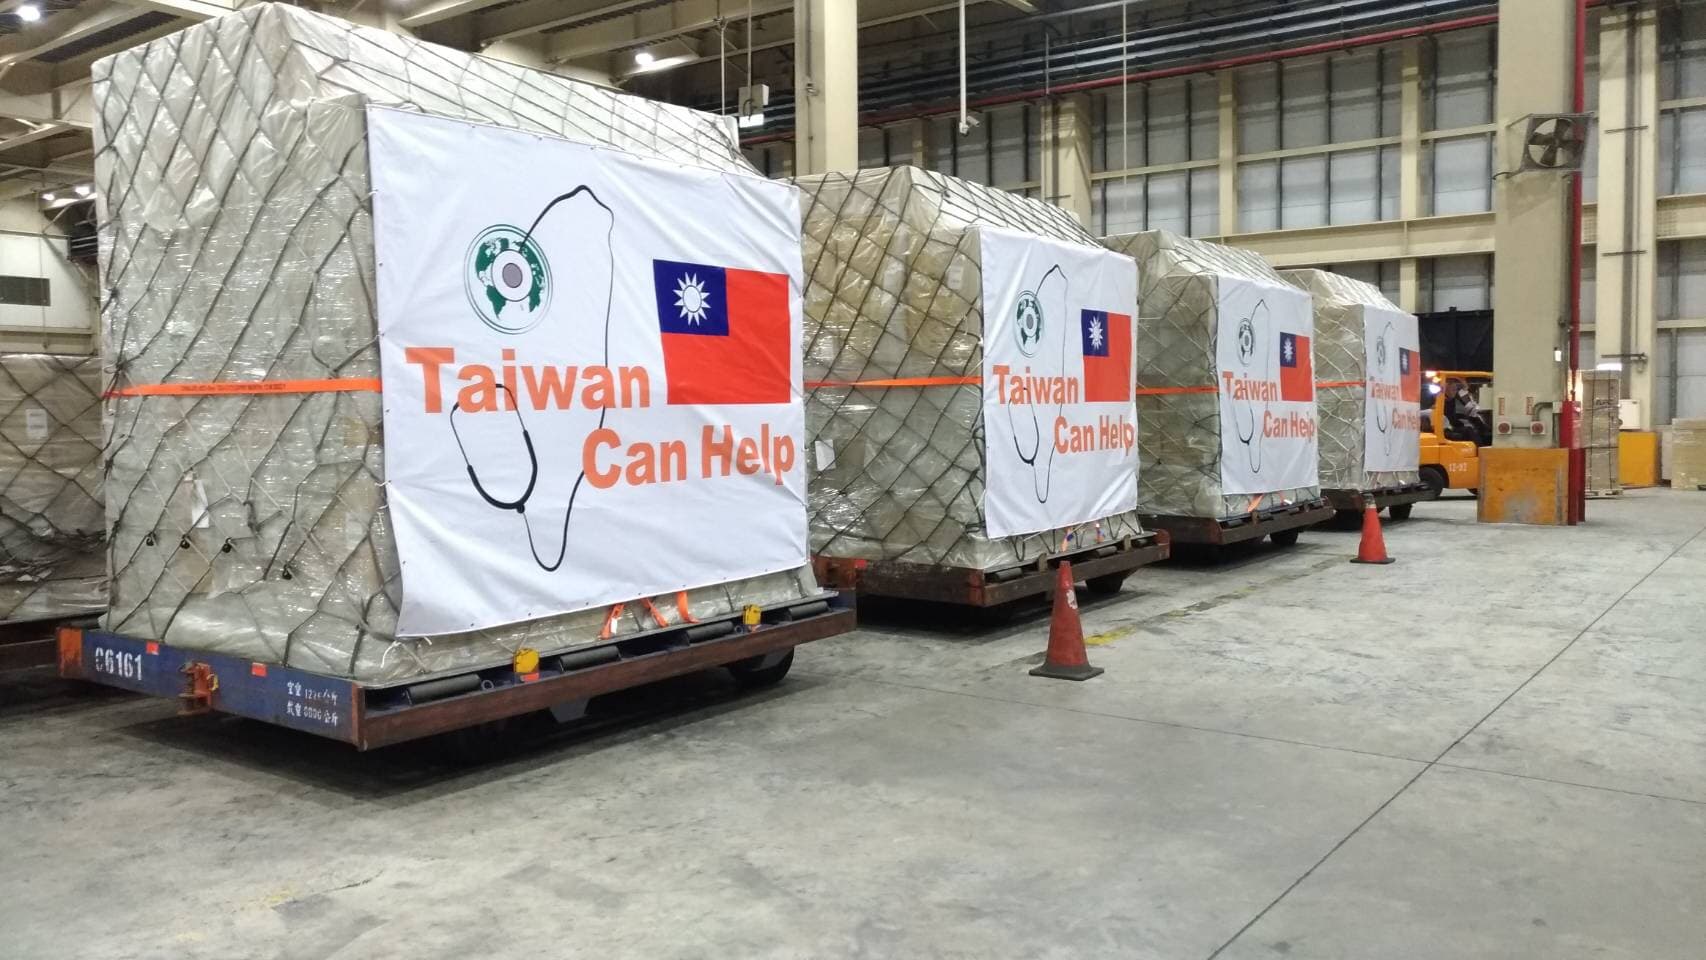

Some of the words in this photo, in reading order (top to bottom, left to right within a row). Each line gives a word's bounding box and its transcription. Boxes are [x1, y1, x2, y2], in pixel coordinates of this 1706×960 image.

[405, 347, 650, 414] Taiwan
[992, 364, 1079, 405] Taiwan
[1222, 371, 1278, 402] Taiwan
[1054, 415, 1095, 455] Can
[1099, 414, 1135, 457] Help
[1263, 410, 1288, 438] Can
[582, 427, 687, 489] Can
[702, 423, 795, 486] Help
